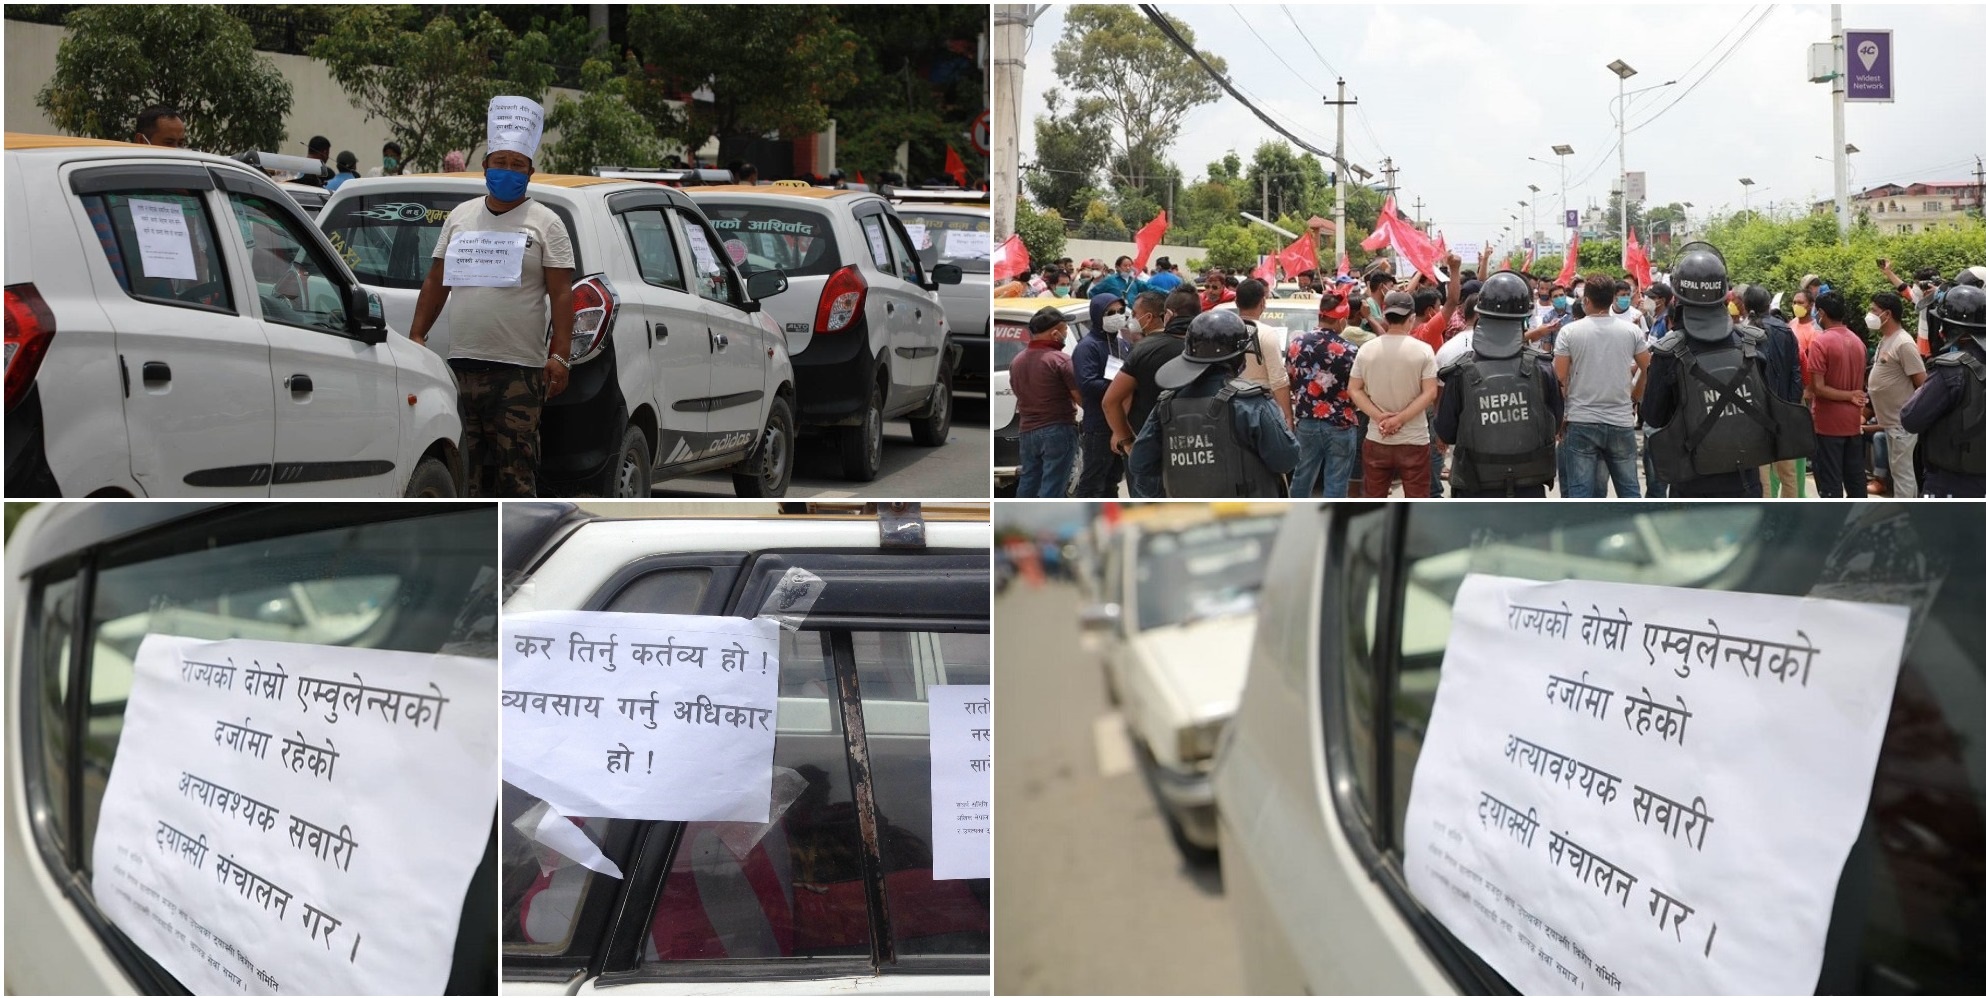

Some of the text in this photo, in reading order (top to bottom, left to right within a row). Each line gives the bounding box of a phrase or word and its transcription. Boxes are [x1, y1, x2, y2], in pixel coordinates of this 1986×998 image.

[1680, 280, 1722, 290] NEPAL POLICE
[1262, 312, 1285, 320] TAXI
[994, 327, 1023, 339] VICE
[1479, 391, 1528, 410] NEPAL
[1481, 407, 1529, 426] POLICE
[709, 432, 751, 452] adidas
[1169, 434, 1214, 450] NEPAL
[1171, 450, 1215, 466] POLICE
[1509, 601, 1572, 640] राज्यको
[1582, 604, 1632, 652] दोस्रो
[514, 631, 768, 675] कर तिर्नु कर्तव्य हो !
[182, 657, 237, 690] राज्यको
[245, 660, 288, 701] दोस्रो
[502, 689, 772, 731] व्यवसाय गर्नु अधिकार
[1546, 671, 1692, 747] दर्जामा रहेको
[214, 717, 340, 782] दर्जामा रहेको
[606, 742, 654, 774] हो !
[1504, 734, 1714, 852] अत्यावश्यक सवारी
[178, 771, 359, 872] अत्यावश्यक सवारी
[1549, 830, 1638, 909] संचालन
[1650, 887, 1695, 943] गर
[216, 854, 294, 921] संचालन
[302, 903, 342, 951] गर
[222, 966, 243, 988] समाज
[256, 968, 279, 992] समिति
[1555, 961, 1578, 987] समाज
[1595, 963, 1622, 992] समिति
